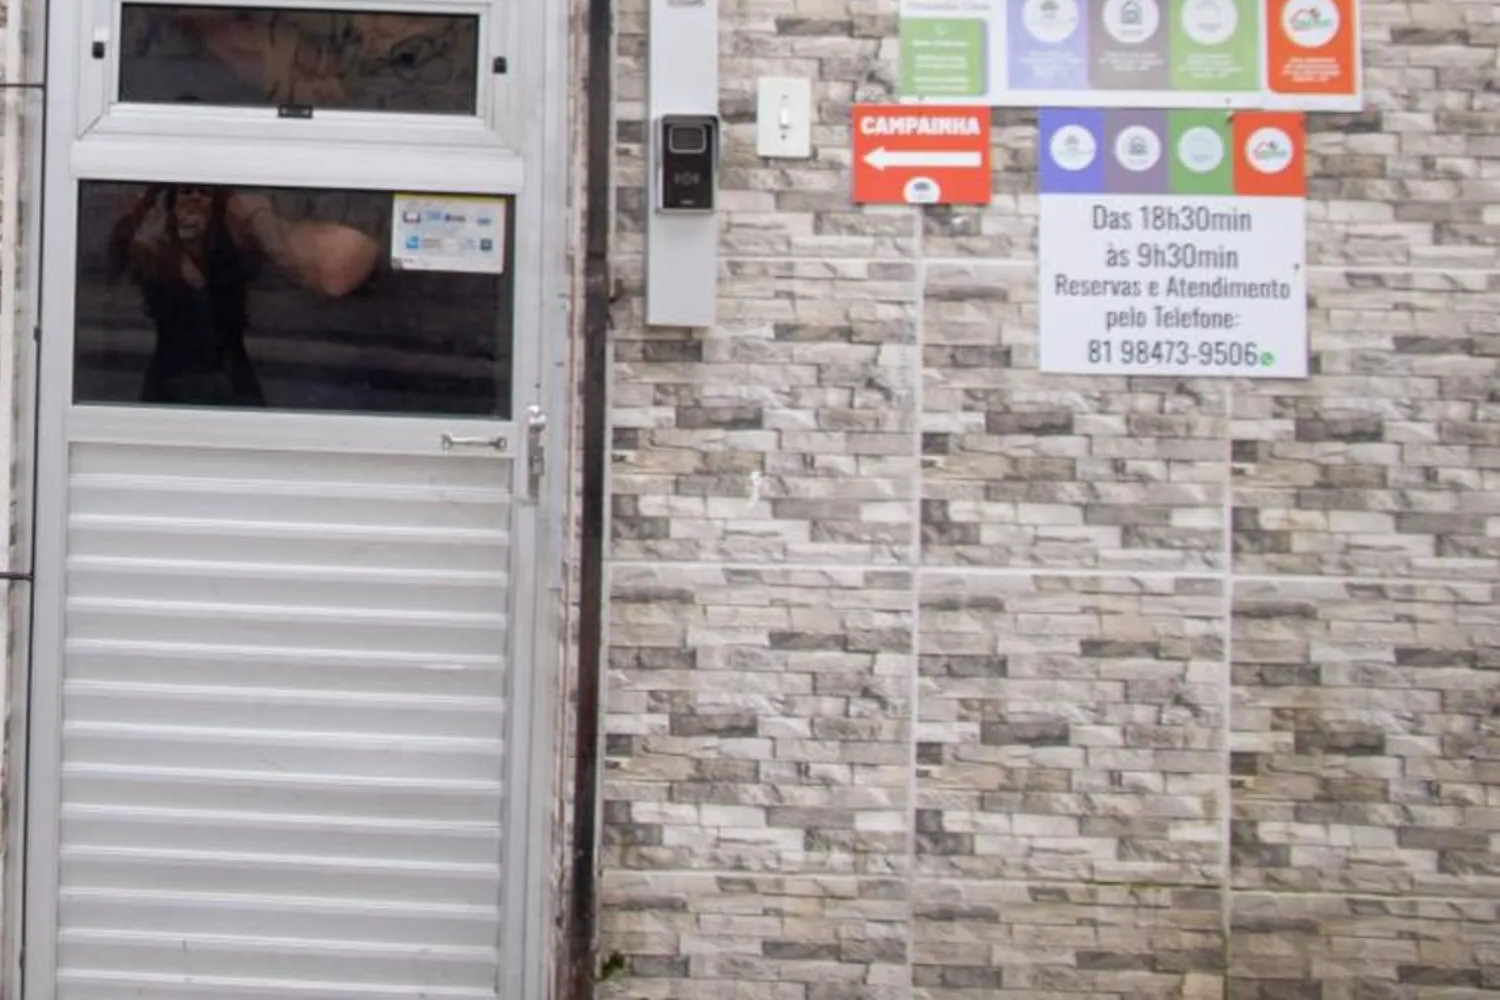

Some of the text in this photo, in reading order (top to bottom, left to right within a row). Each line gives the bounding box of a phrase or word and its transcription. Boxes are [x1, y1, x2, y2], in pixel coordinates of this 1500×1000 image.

[860, 115, 981, 136] CAMPAINHA
[1092, 204, 1252, 232] Das 18h30min
[1105, 243, 1238, 269] às 9h30min
[1055, 273, 1291, 300] Reservas e Atendimento
[1106, 306, 1241, 332] pelo Telefone:
[1088, 340, 1258, 366] 81 98473-9506
